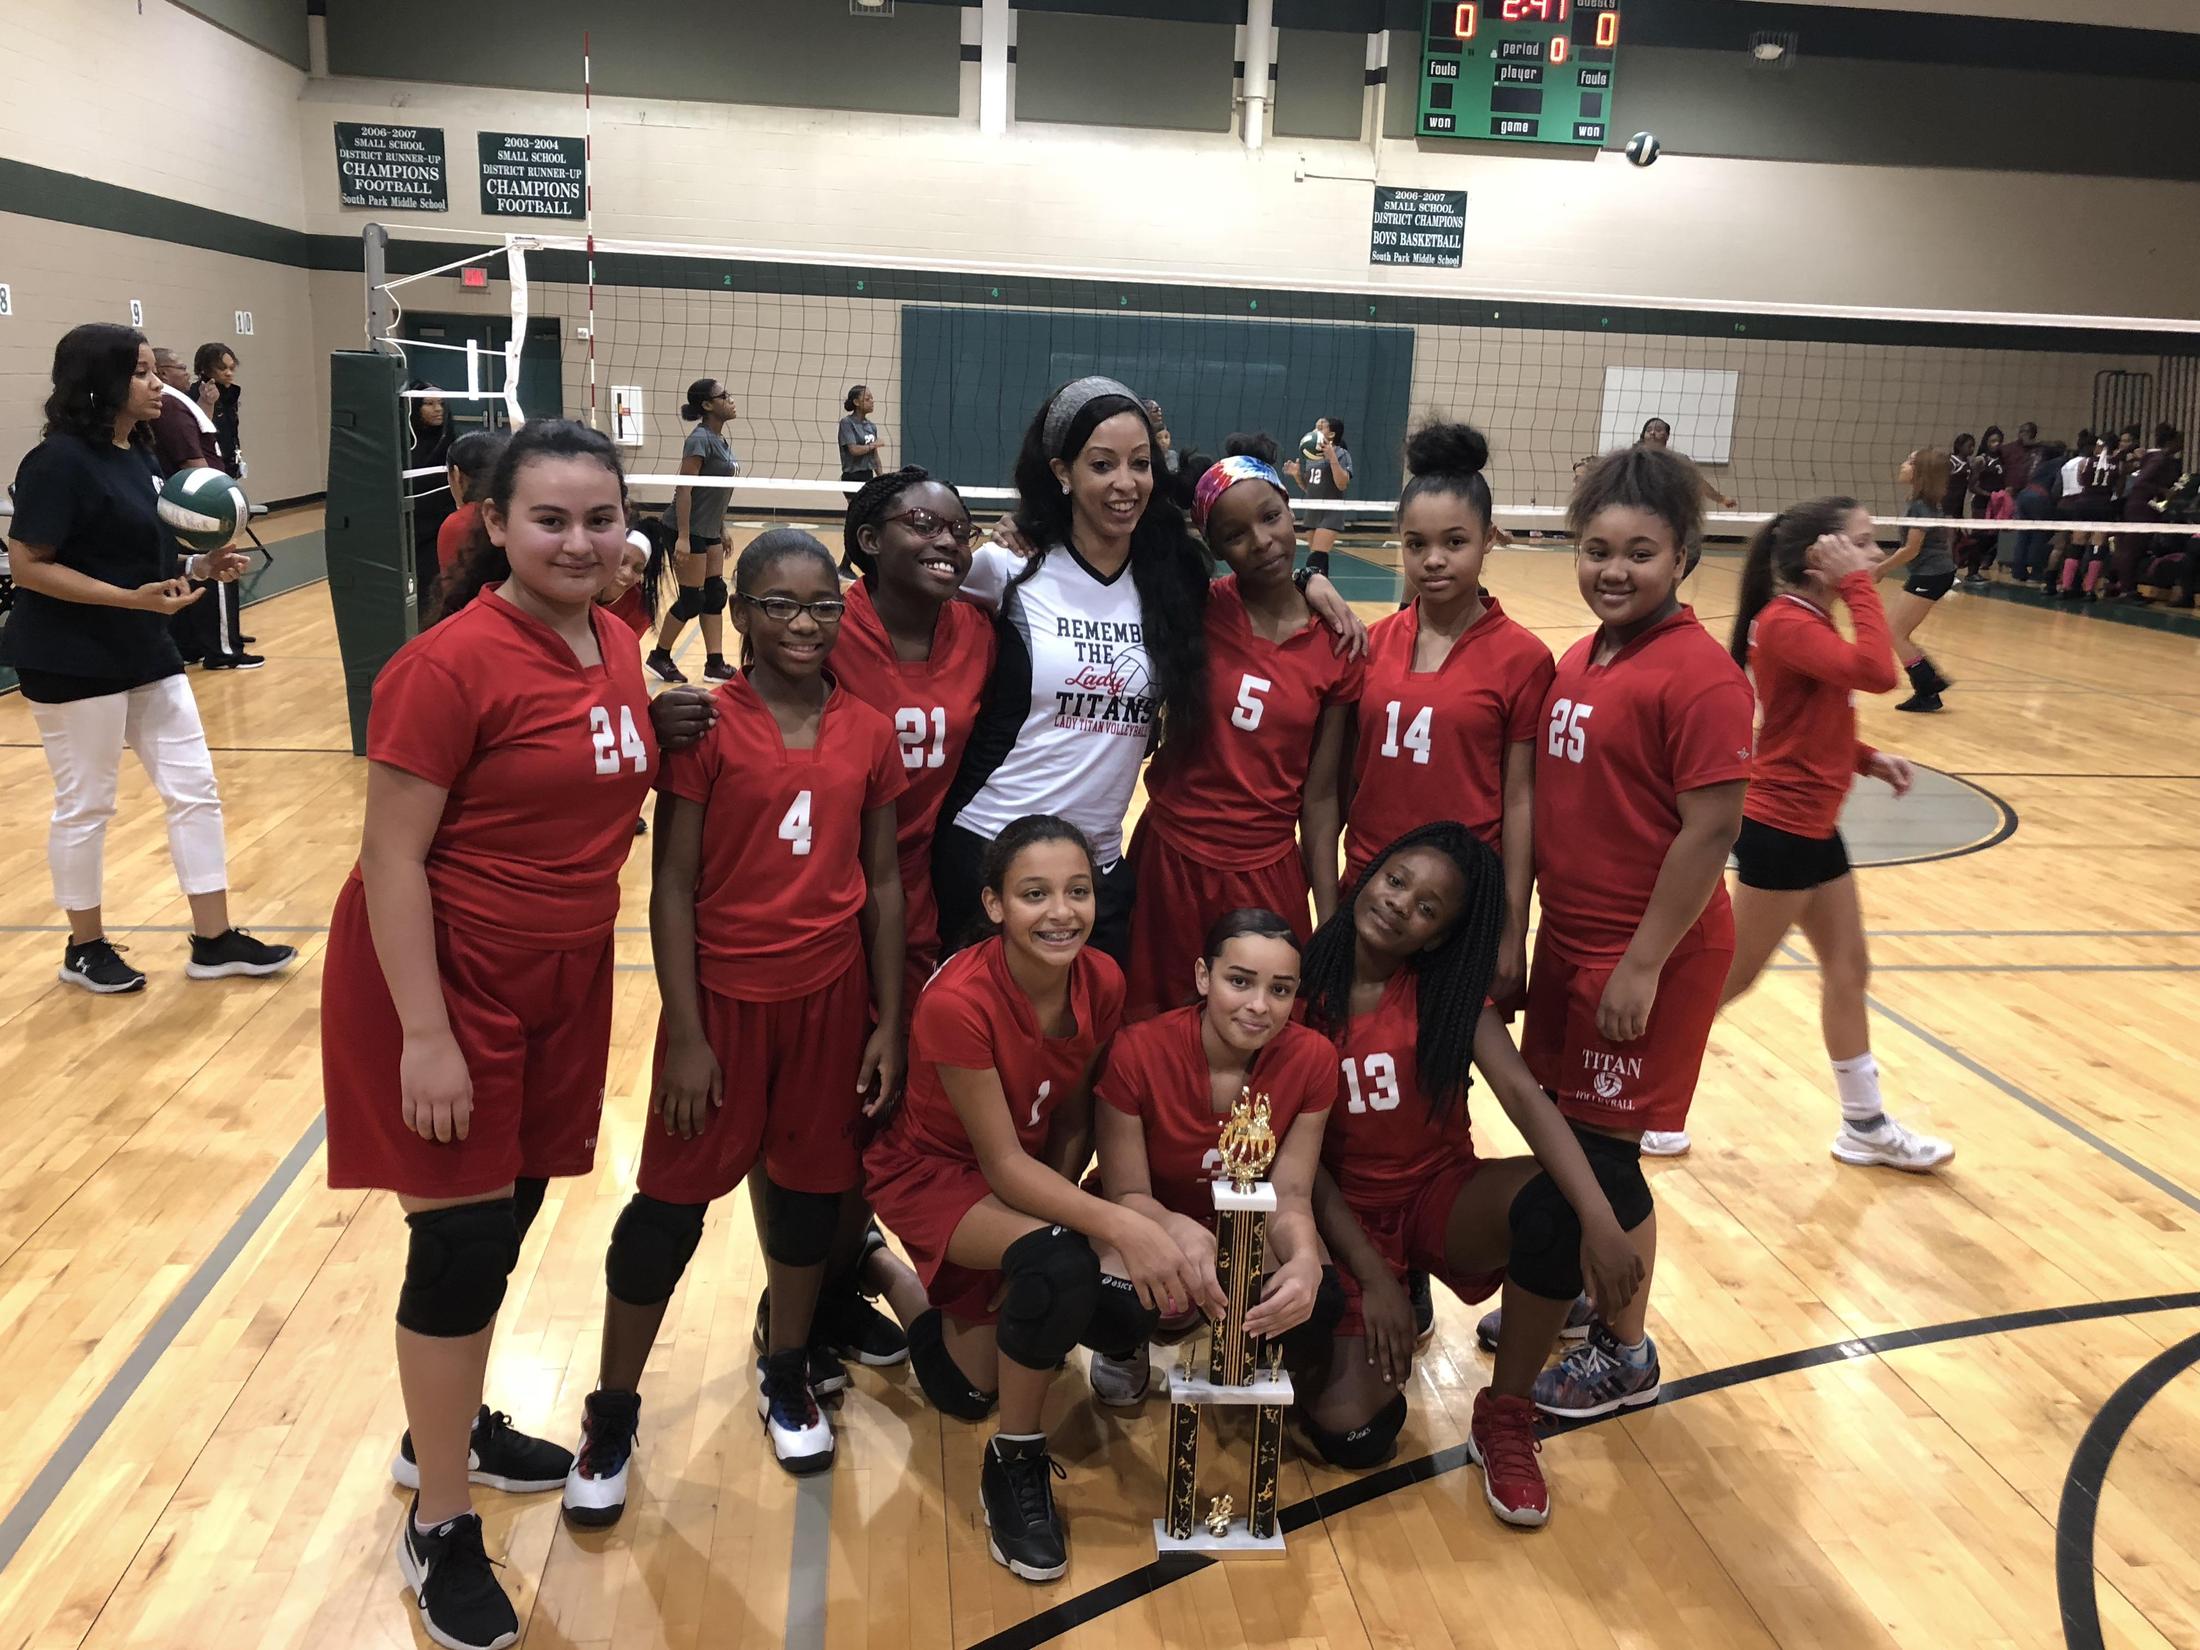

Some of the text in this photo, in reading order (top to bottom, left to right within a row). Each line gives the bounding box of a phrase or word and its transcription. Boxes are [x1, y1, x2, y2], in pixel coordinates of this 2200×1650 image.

[1455, 3, 1475, 38] 0
[1596, 12, 1618, 47] 0
[1502, 42, 1539, 56] period
[1550, 36, 1566, 63] 0
[1430, 62, 1457, 76] fouls
[1501, 65, 1537, 81] player
[1580, 71, 1607, 86] fouls
[1429, 116, 1451, 129] won
[1501, 120, 1529, 133] game
[1578, 125, 1600, 137] won
[361, 126, 417, 139] 2006-2007
[354, 138, 425, 151] SMALL SCHOOL
[504, 136, 559, 150] 2003-2004
[339, 148, 441, 165] DISTRICT RUNNER-UP
[497, 150, 567, 164] SMALL SCHOOL
[342, 161, 440, 181] CHAMPIONS
[483, 164, 582, 180] DISTRICT RUNNER-UP
[355, 179, 432, 194] FOOTBALL
[486, 178, 580, 199] CHAMPIONS
[342, 193, 446, 210] South Park Middle School
[1395, 190, 1445, 202] 2006-2007
[496, 198, 572, 215] FOOTBALL
[1384, 201, 1454, 214] SMALL SCHOOL
[1374, 212, 1463, 228] DISTRICT CHAMPIONS
[1373, 231, 1461, 248] BOYS BASKETBALL
[1372, 250, 1459, 265] South Park Middle School
[723, 275, 732, 285] 2
[856, 280, 864, 290] 3
[132, 303, 140, 325] 9
[1369, 305, 1376, 316] 7
[237, 314, 252, 333] 10
[1309, 468, 1321, 484] 12
[1056, 617, 1143, 643] REMEMB
[1074, 641, 1114, 665] THE
[1064, 666, 1126, 695] Lady
[1056, 692, 1151, 724] TITANS
[1230, 673, 1271, 732] 5
[1054, 716, 1078, 730] LADY
[1079, 718, 1105, 733] TITAN
[1380, 700, 1433, 764] 14
[1547, 698, 1593, 764] 25
[589, 705, 647, 775] 24
[894, 706, 946, 768] 21
[777, 790, 812, 855] 4
[1582, 1049, 1643, 1080] TITAN
[1340, 1051, 1400, 1114] 13
